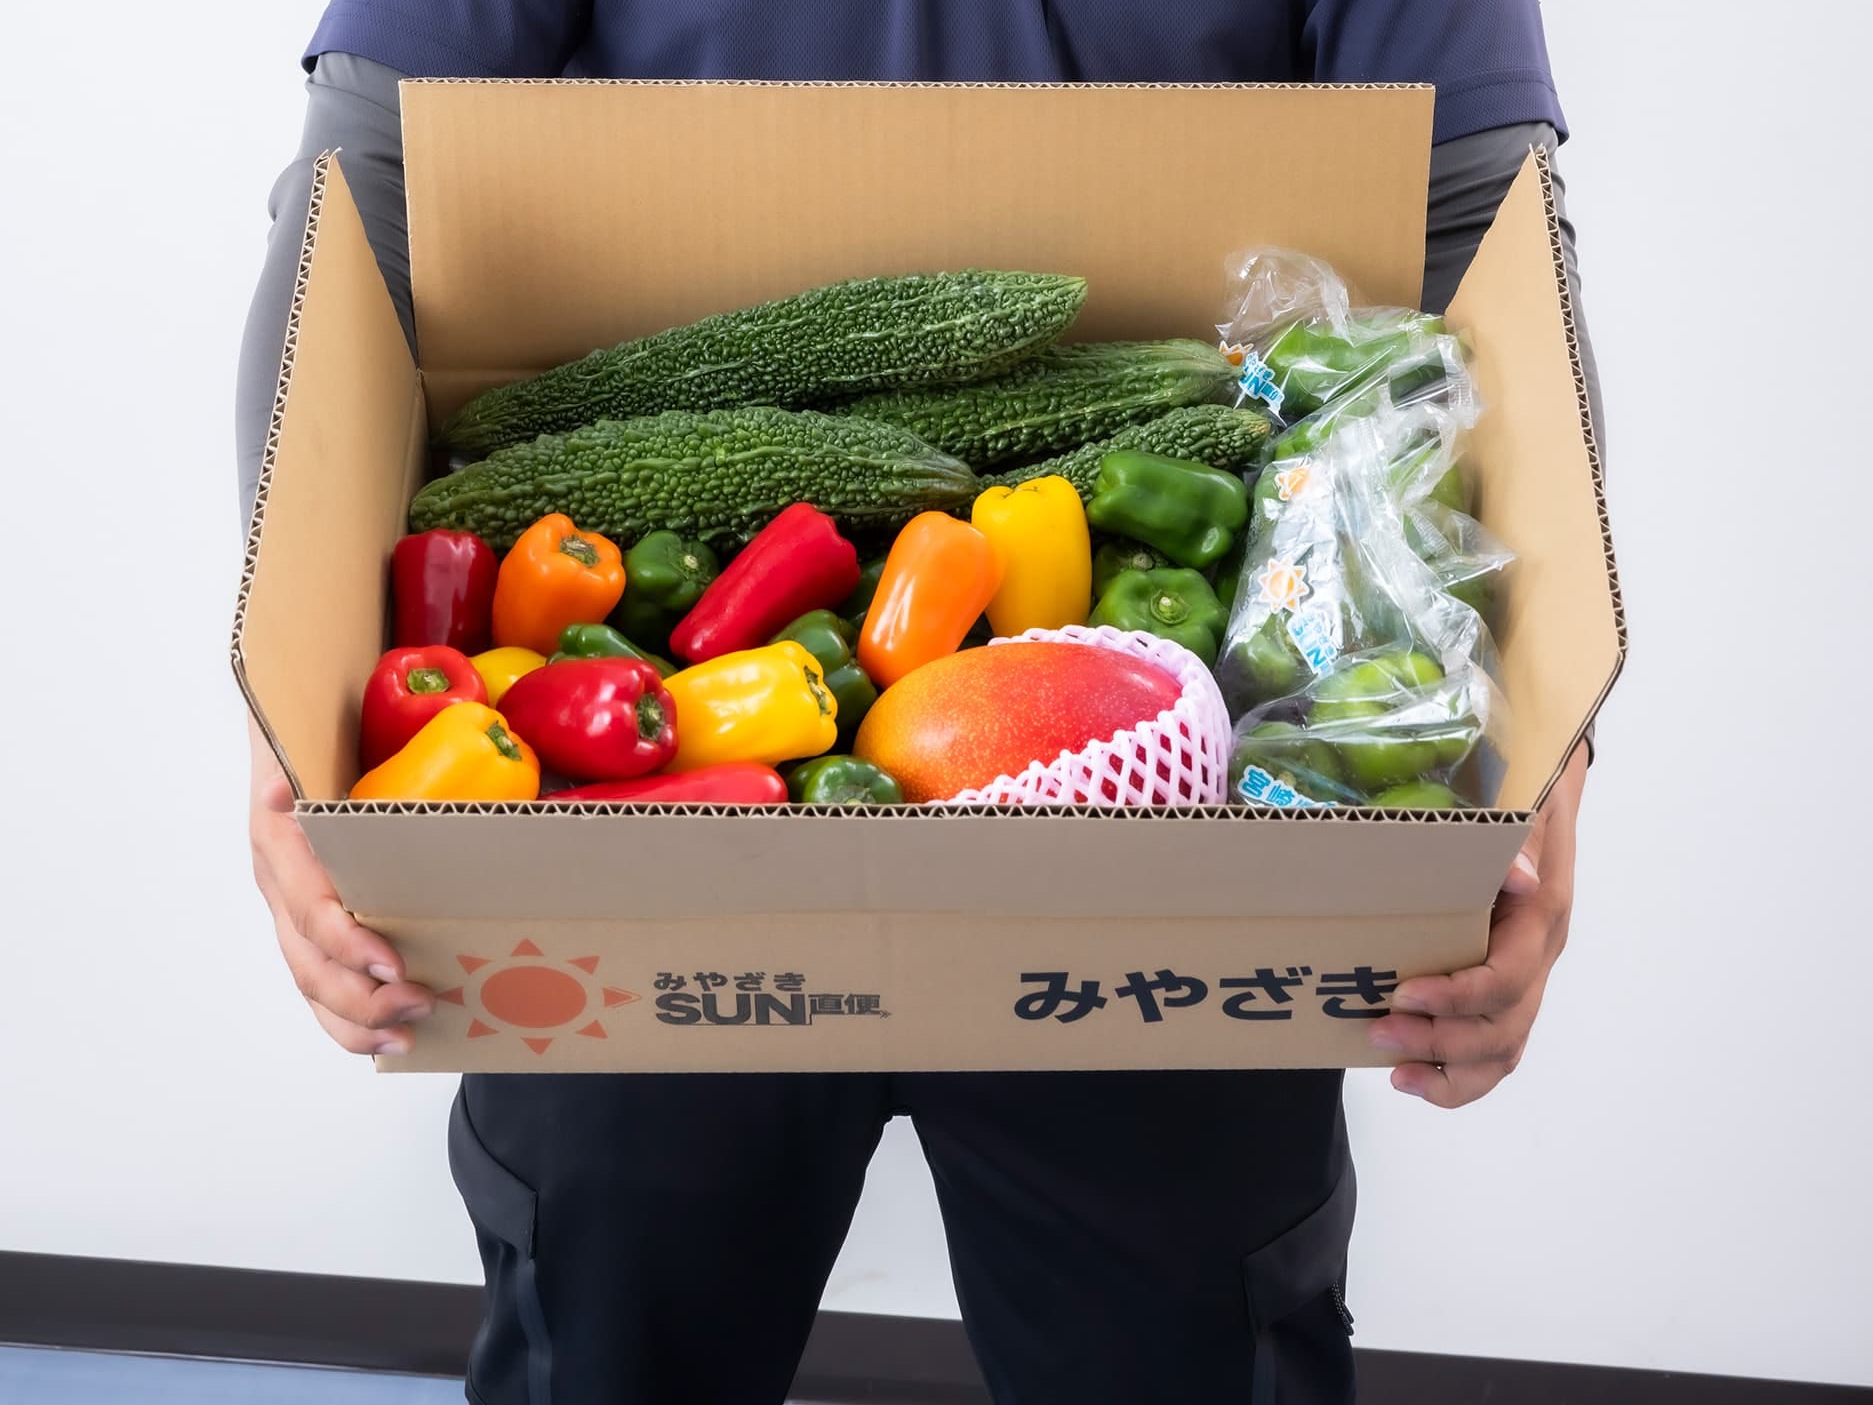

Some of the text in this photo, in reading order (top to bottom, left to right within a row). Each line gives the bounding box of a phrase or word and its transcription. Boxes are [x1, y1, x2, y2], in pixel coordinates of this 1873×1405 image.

[653, 971, 806, 992] みやざき
[1014, 966, 1398, 1024] みやざき
